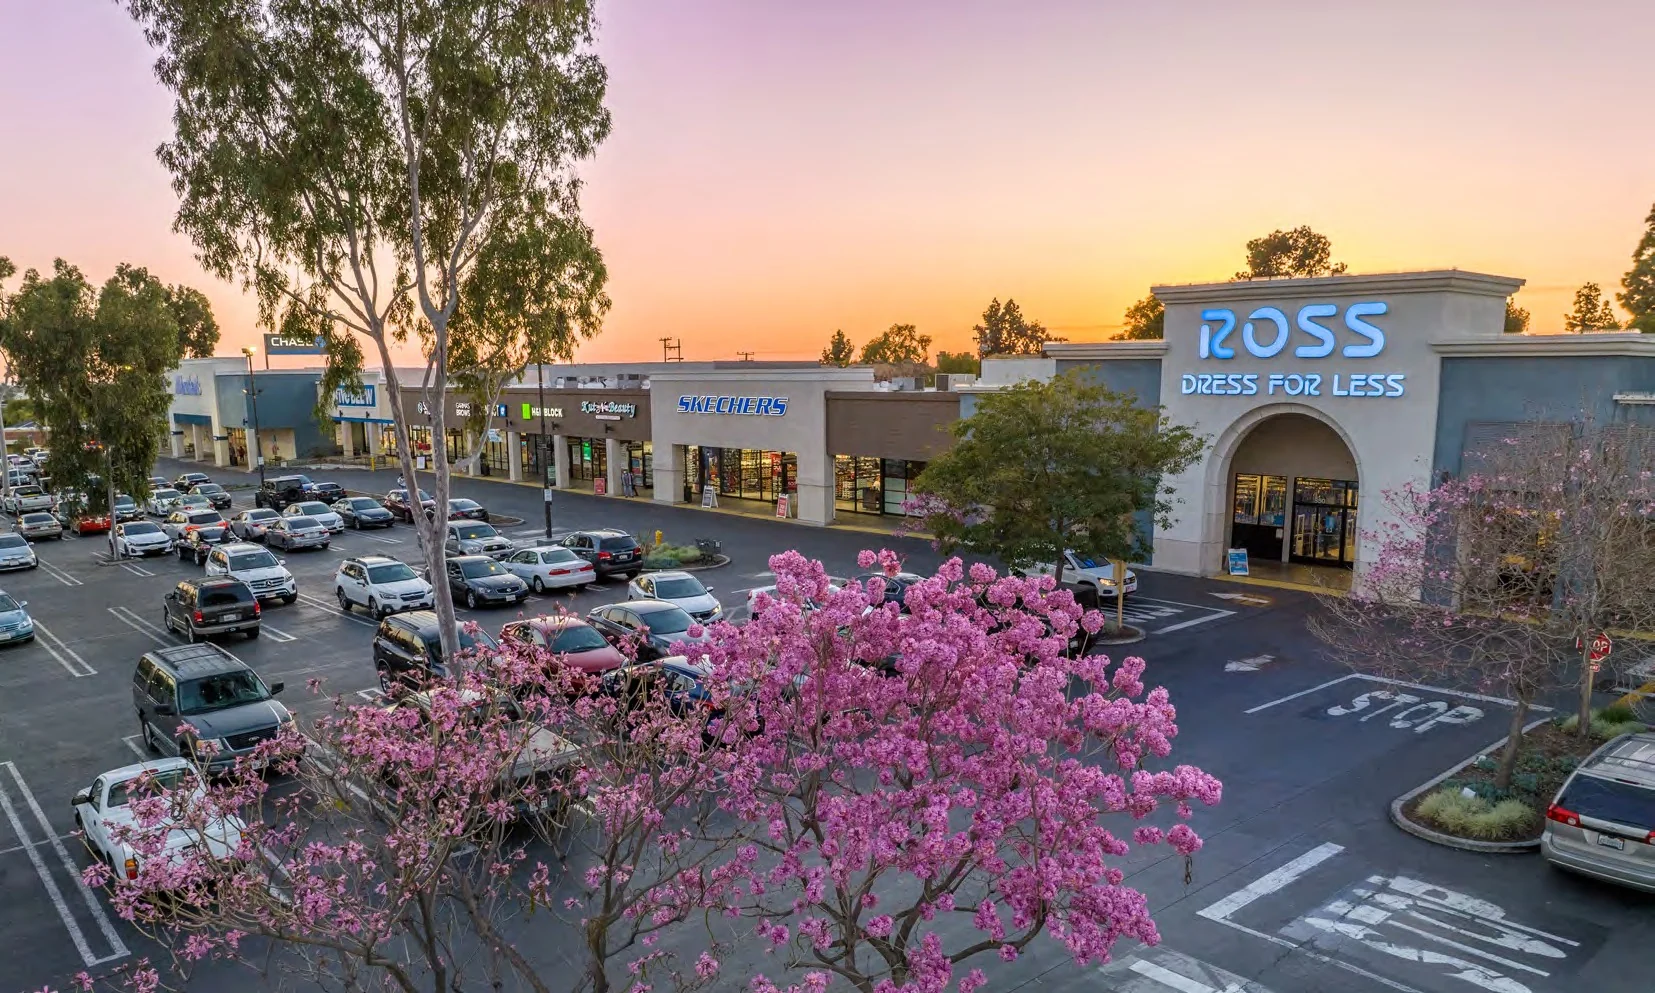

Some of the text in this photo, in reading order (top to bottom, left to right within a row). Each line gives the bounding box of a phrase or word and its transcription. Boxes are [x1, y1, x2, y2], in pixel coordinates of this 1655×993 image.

[1199, 302, 1388, 360] ROSS
[1181, 374, 1405, 397] DRESS FOR LESS
[543, 407, 563, 418] BLOCK
[677, 395, 789, 417] SKECHERS
[1327, 690, 1485, 734] STOP
